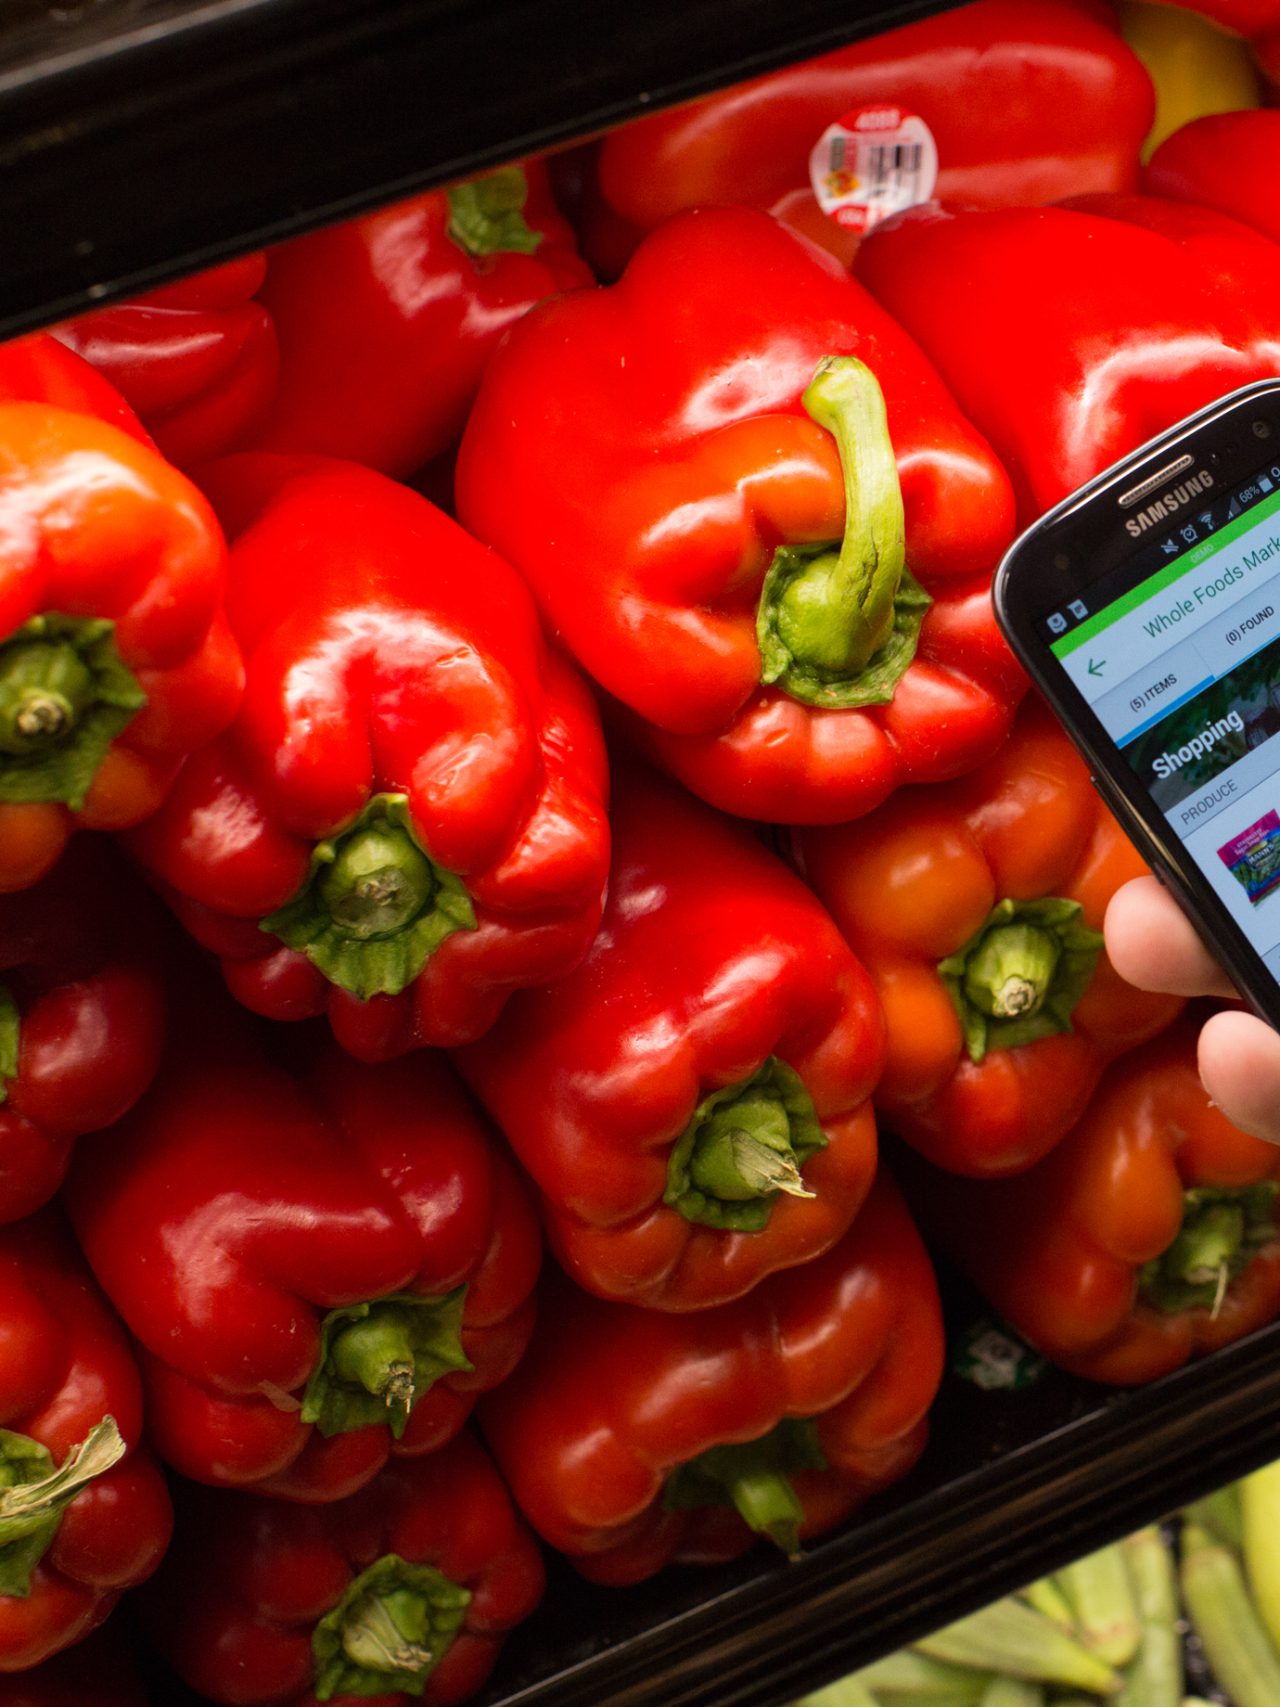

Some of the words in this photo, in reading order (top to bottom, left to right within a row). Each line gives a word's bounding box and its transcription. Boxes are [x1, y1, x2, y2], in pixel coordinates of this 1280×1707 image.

[1125, 470, 1214, 537] SAMSUNG
[1239, 486, 1260, 503] 68%
[1143, 601, 1195, 638] Whole
[1193, 565, 1244, 605] Foods
[1225, 629, 1241, 646] (0)
[1239, 606, 1274, 635] FOUND
[1129, 695, 1146, 713] (5)
[1144, 673, 1177, 702] ITEMS
[1152, 710, 1244, 779] Shopping
[1180, 779, 1238, 825] PRODUCE
